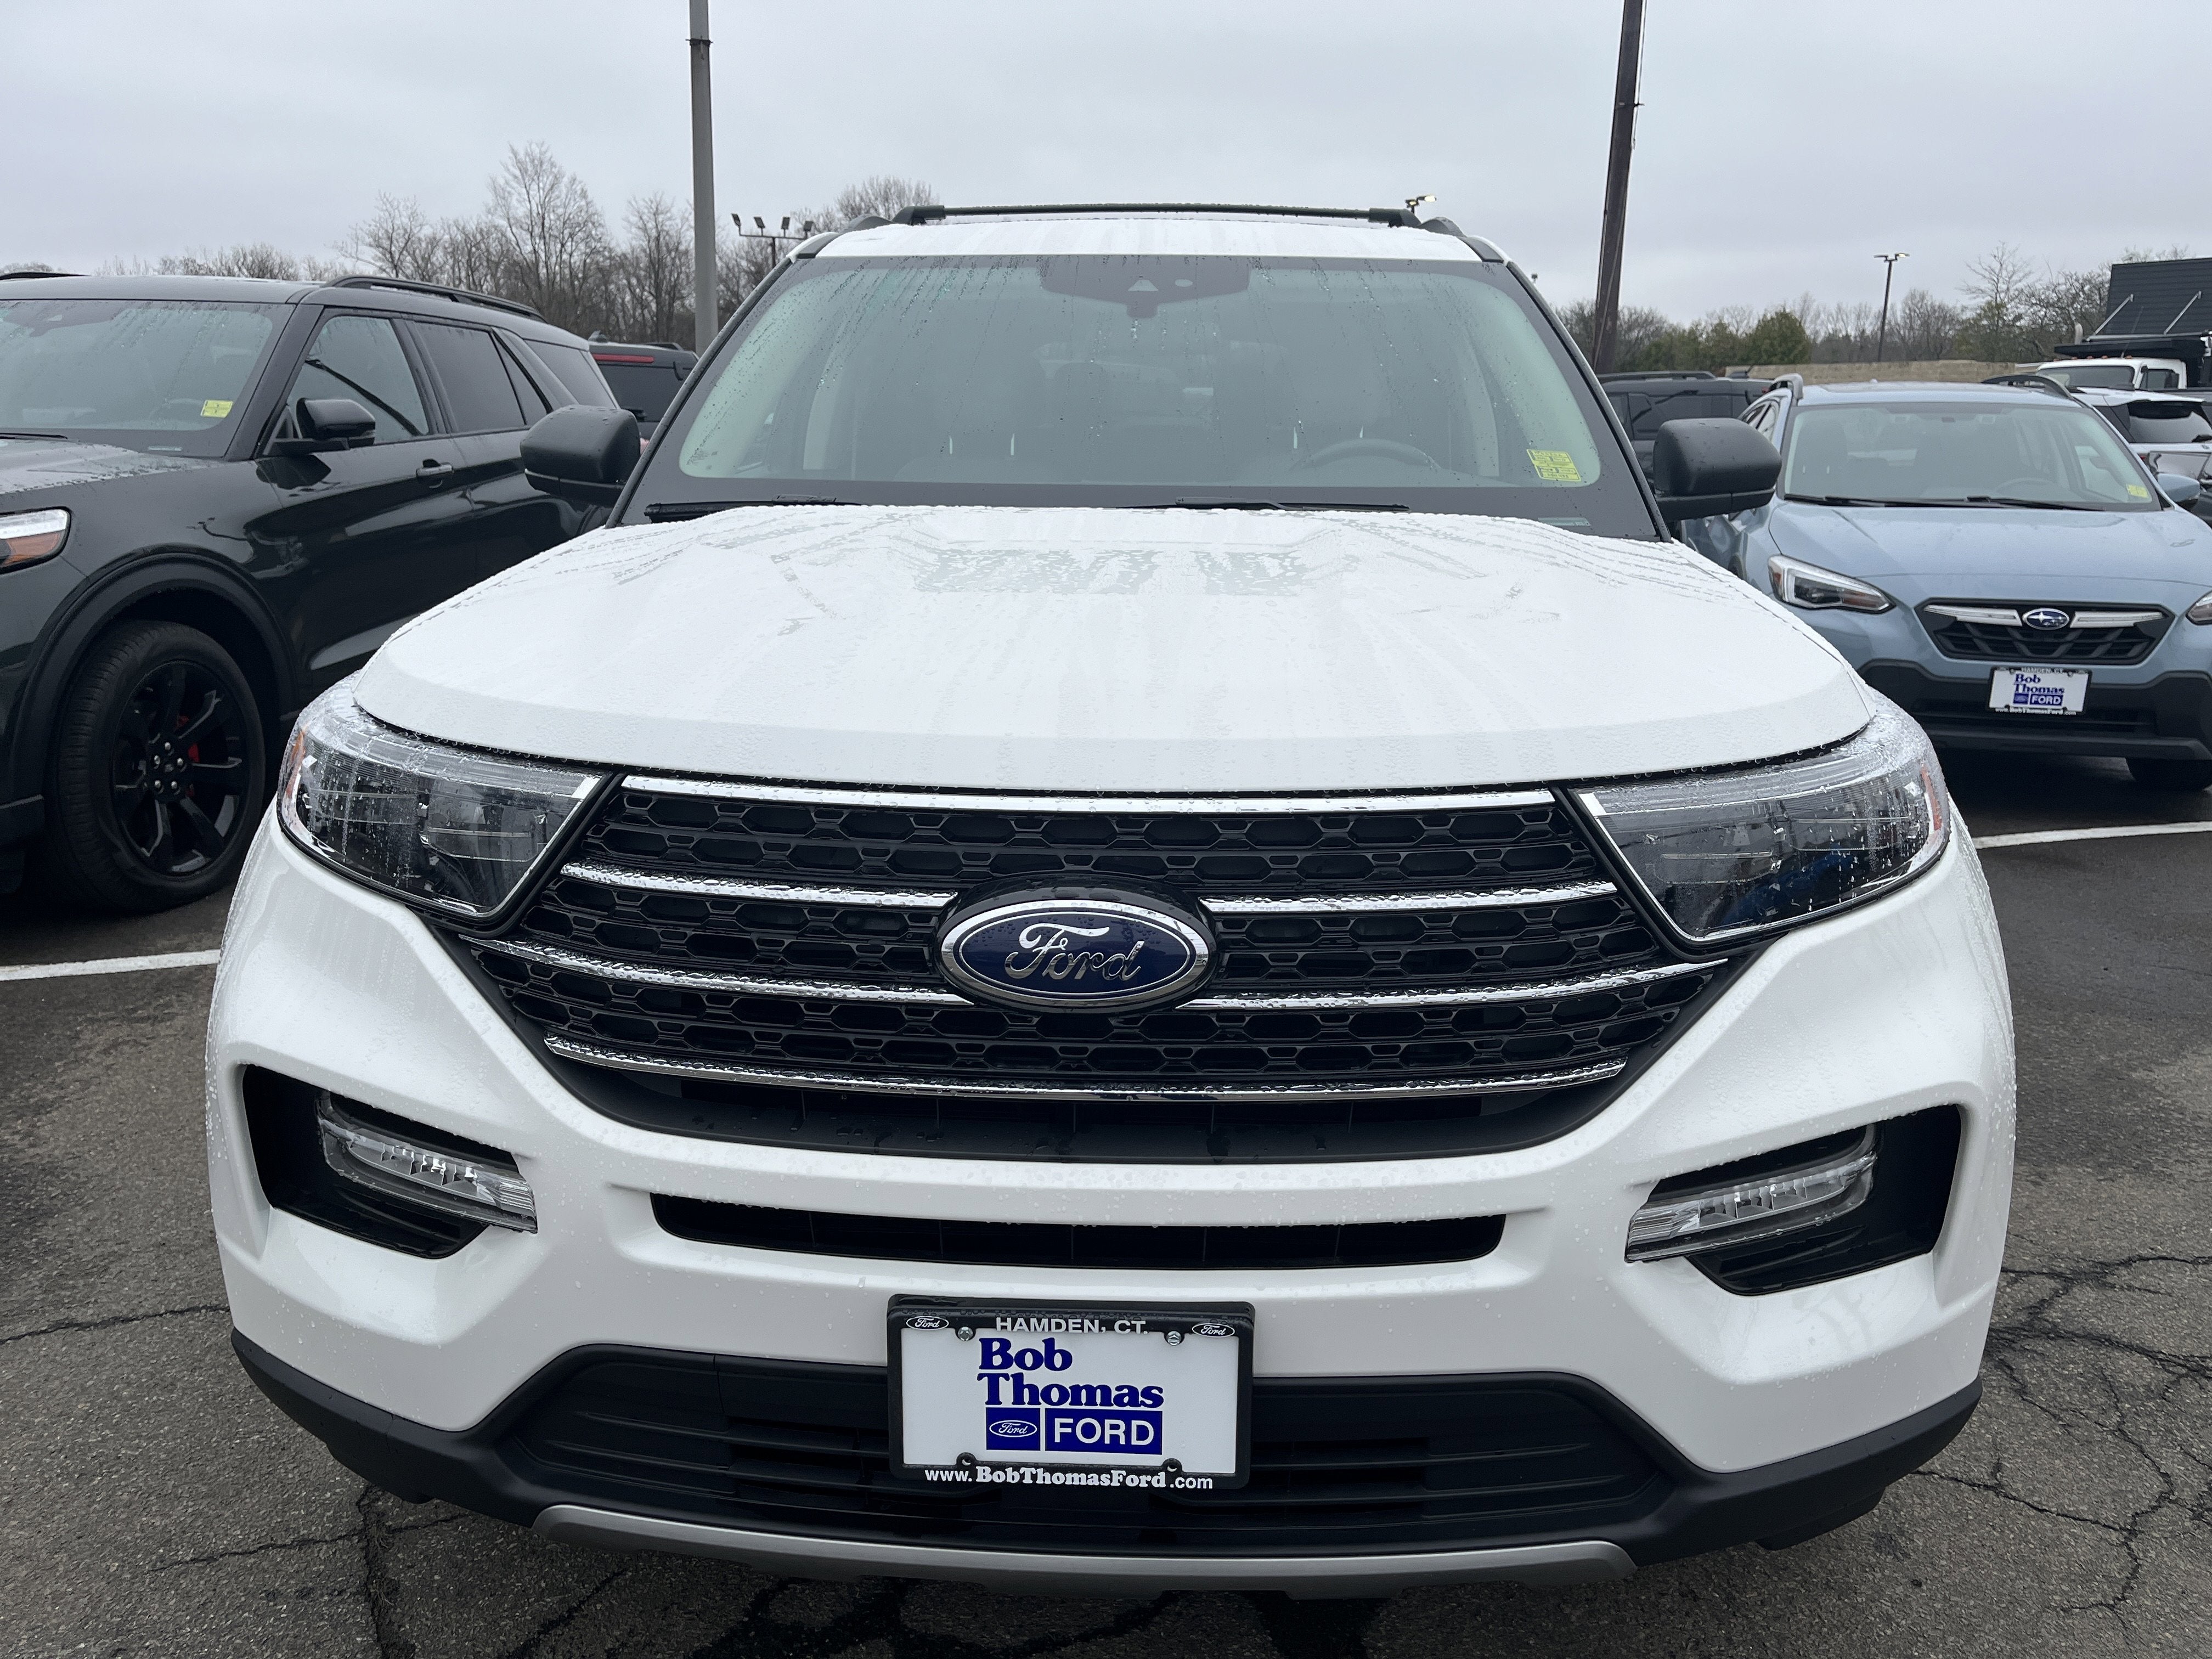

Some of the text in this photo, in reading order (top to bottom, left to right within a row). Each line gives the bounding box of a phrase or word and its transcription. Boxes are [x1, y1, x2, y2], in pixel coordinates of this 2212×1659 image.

[2015, 674, 2041, 684] Bob
[2014, 684, 2065, 693] Thomas
[2032, 695, 2061, 704] FORD
[1005, 923, 1144, 981] Ford
[915, 1317, 940, 1328] Ford
[996, 1317, 1149, 1334] HAMDEN, CT.
[1200, 1325, 1226, 1335] Ford
[979, 1337, 1073, 1371] Bob
[977, 1372, 1164, 1408] Thomas
[998, 1418, 1154, 1446] Ford FORD
